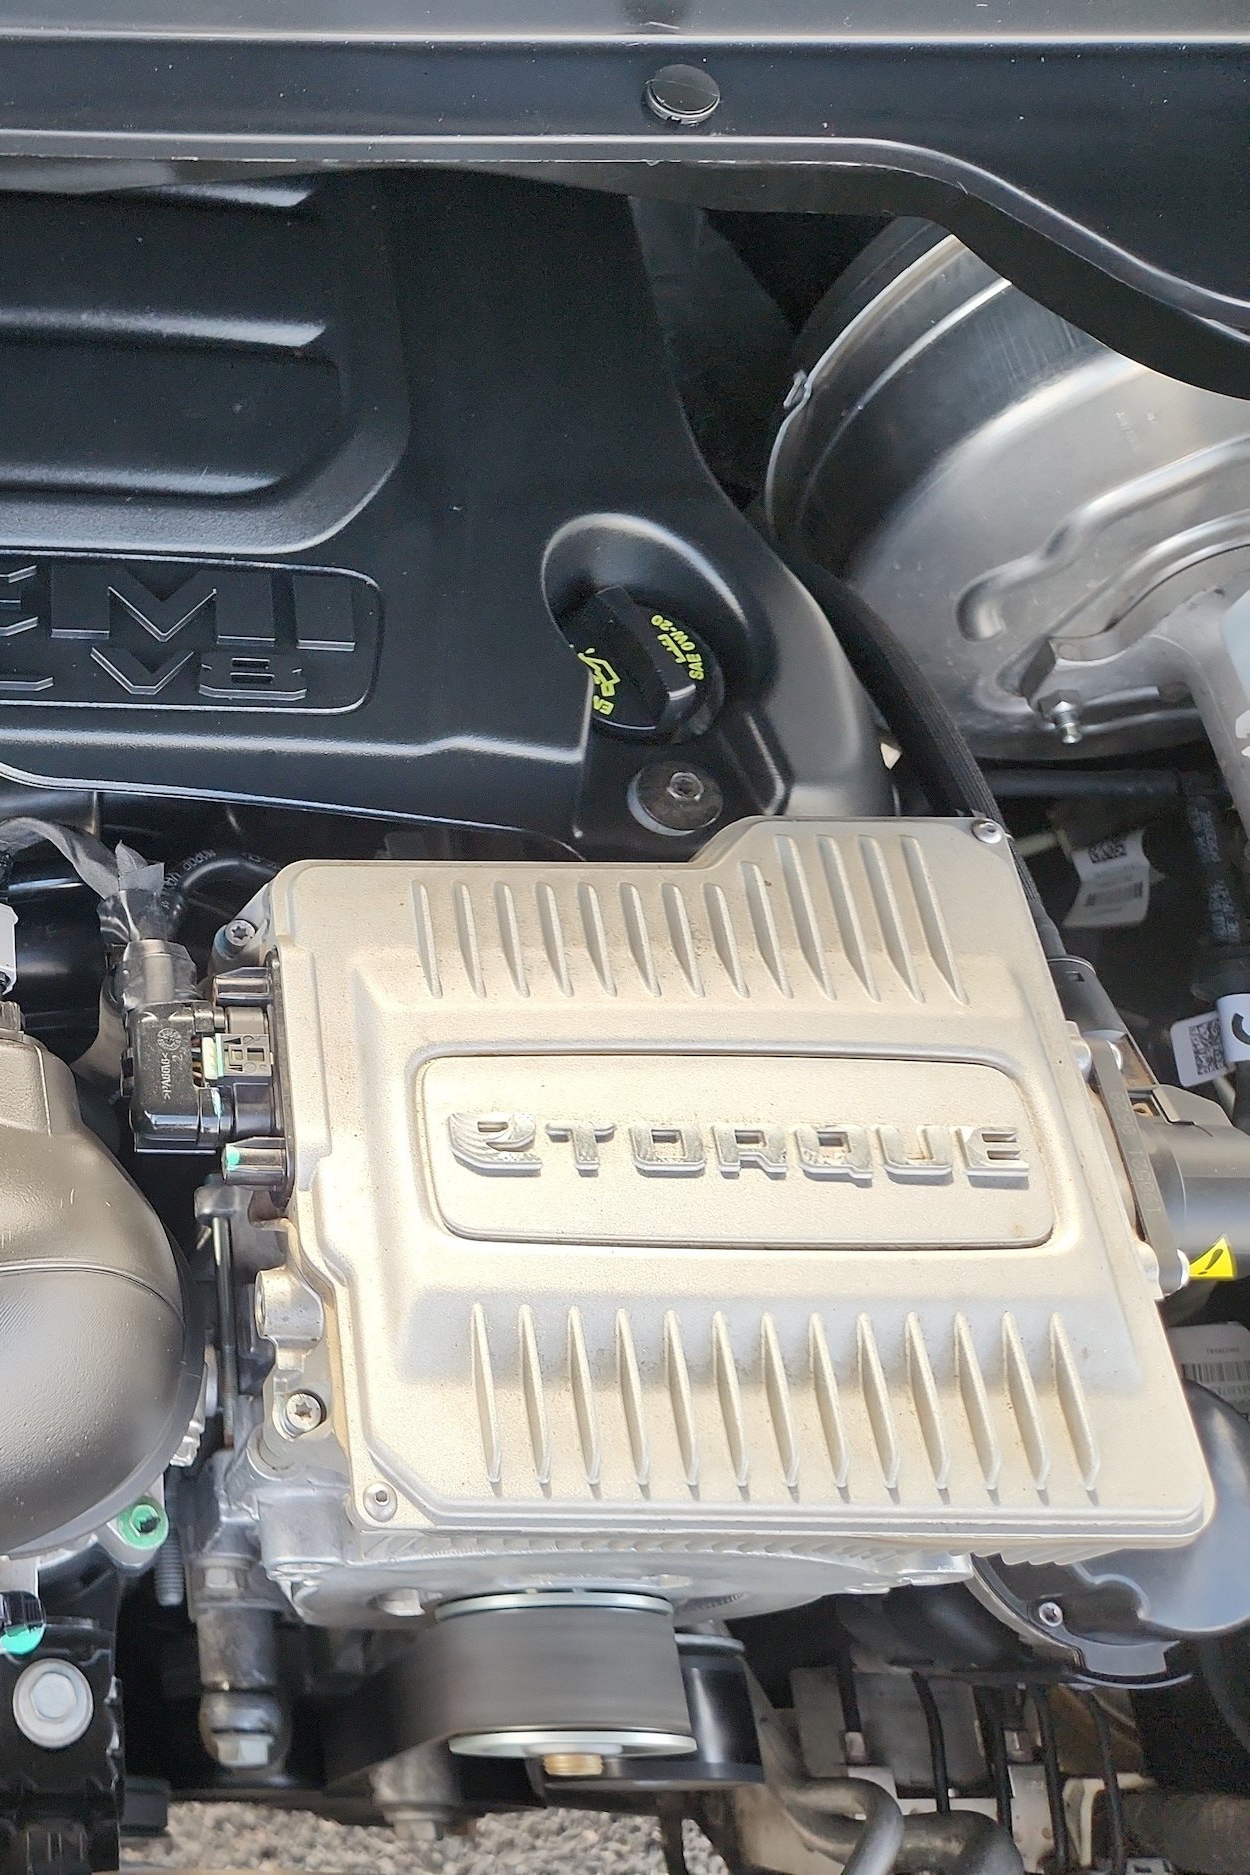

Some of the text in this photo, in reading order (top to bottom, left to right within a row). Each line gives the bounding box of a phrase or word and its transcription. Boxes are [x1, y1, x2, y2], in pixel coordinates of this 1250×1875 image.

[88, 645, 309, 702] V8
[685, 653, 705, 680] SAE
[447, 1111, 1030, 1190] eTORQUE
